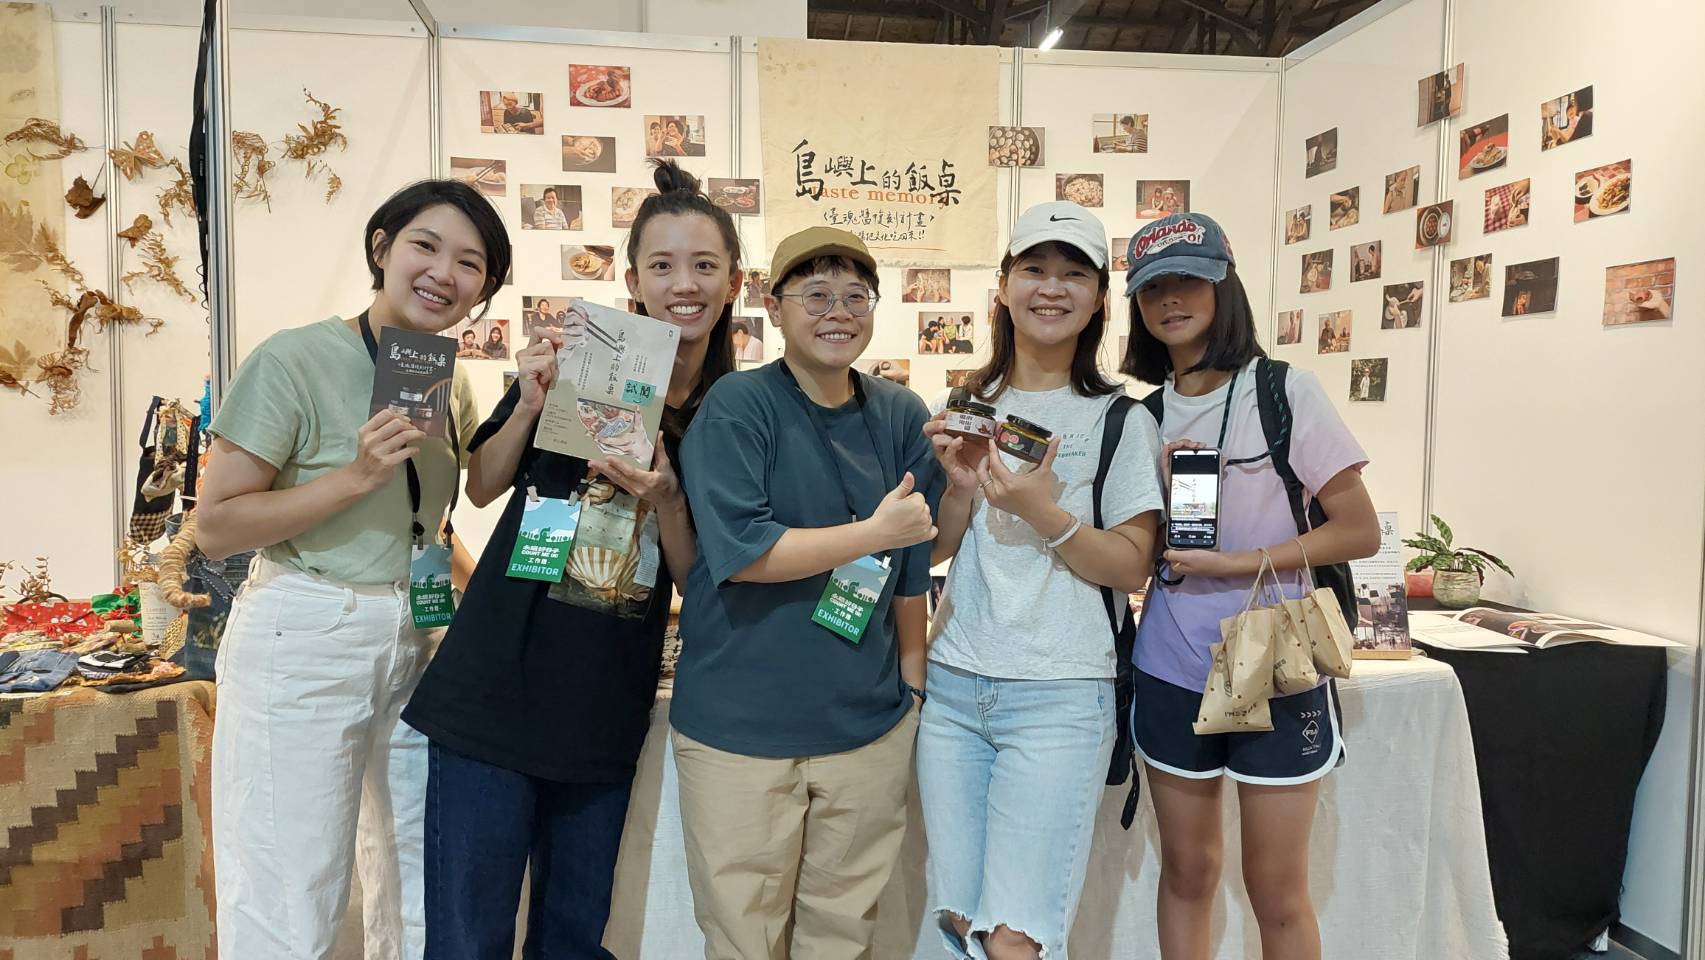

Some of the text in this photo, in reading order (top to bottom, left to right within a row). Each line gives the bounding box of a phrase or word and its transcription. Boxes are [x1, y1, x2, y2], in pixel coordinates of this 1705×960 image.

[792, 139, 962, 206] 島嶼上的飯桌
[1135, 220, 1197, 259] Orlando
[511, 563, 558, 575] EXHIBITOR
[415, 612, 450, 622] EXHIBITOR
[817, 608, 859, 636] EXHIBITOR
